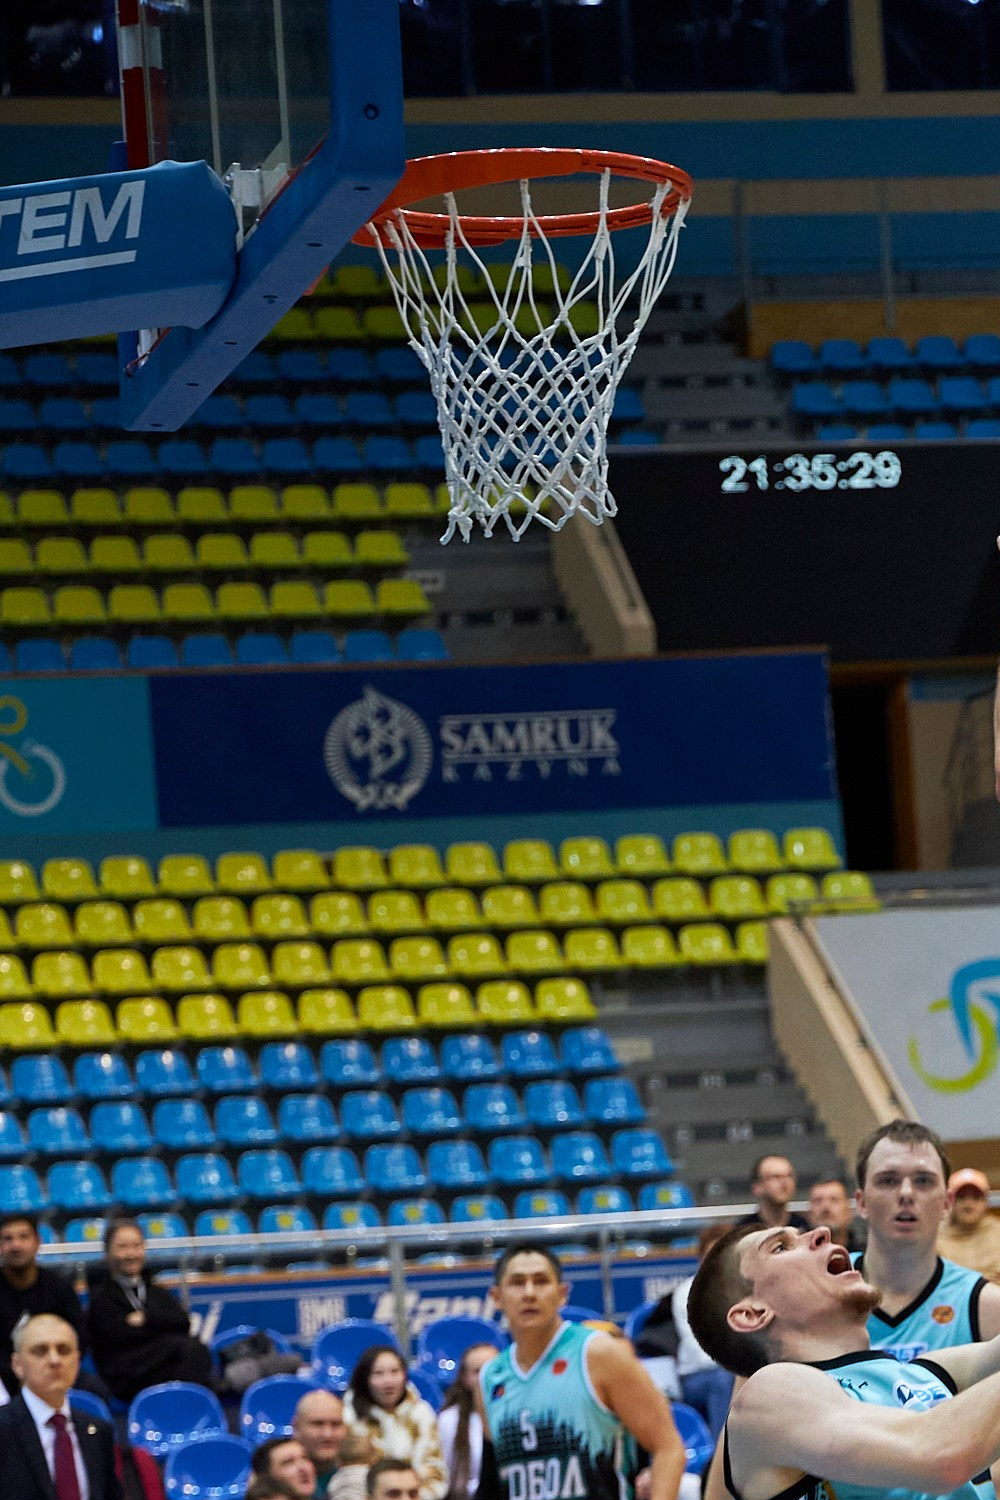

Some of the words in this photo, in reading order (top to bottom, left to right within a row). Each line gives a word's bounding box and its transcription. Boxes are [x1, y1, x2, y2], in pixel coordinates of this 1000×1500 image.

[719, 450, 902, 494] 21:35:29
[440, 710, 620, 758] SAMRUK
[519, 1409, 538, 1451] 5
